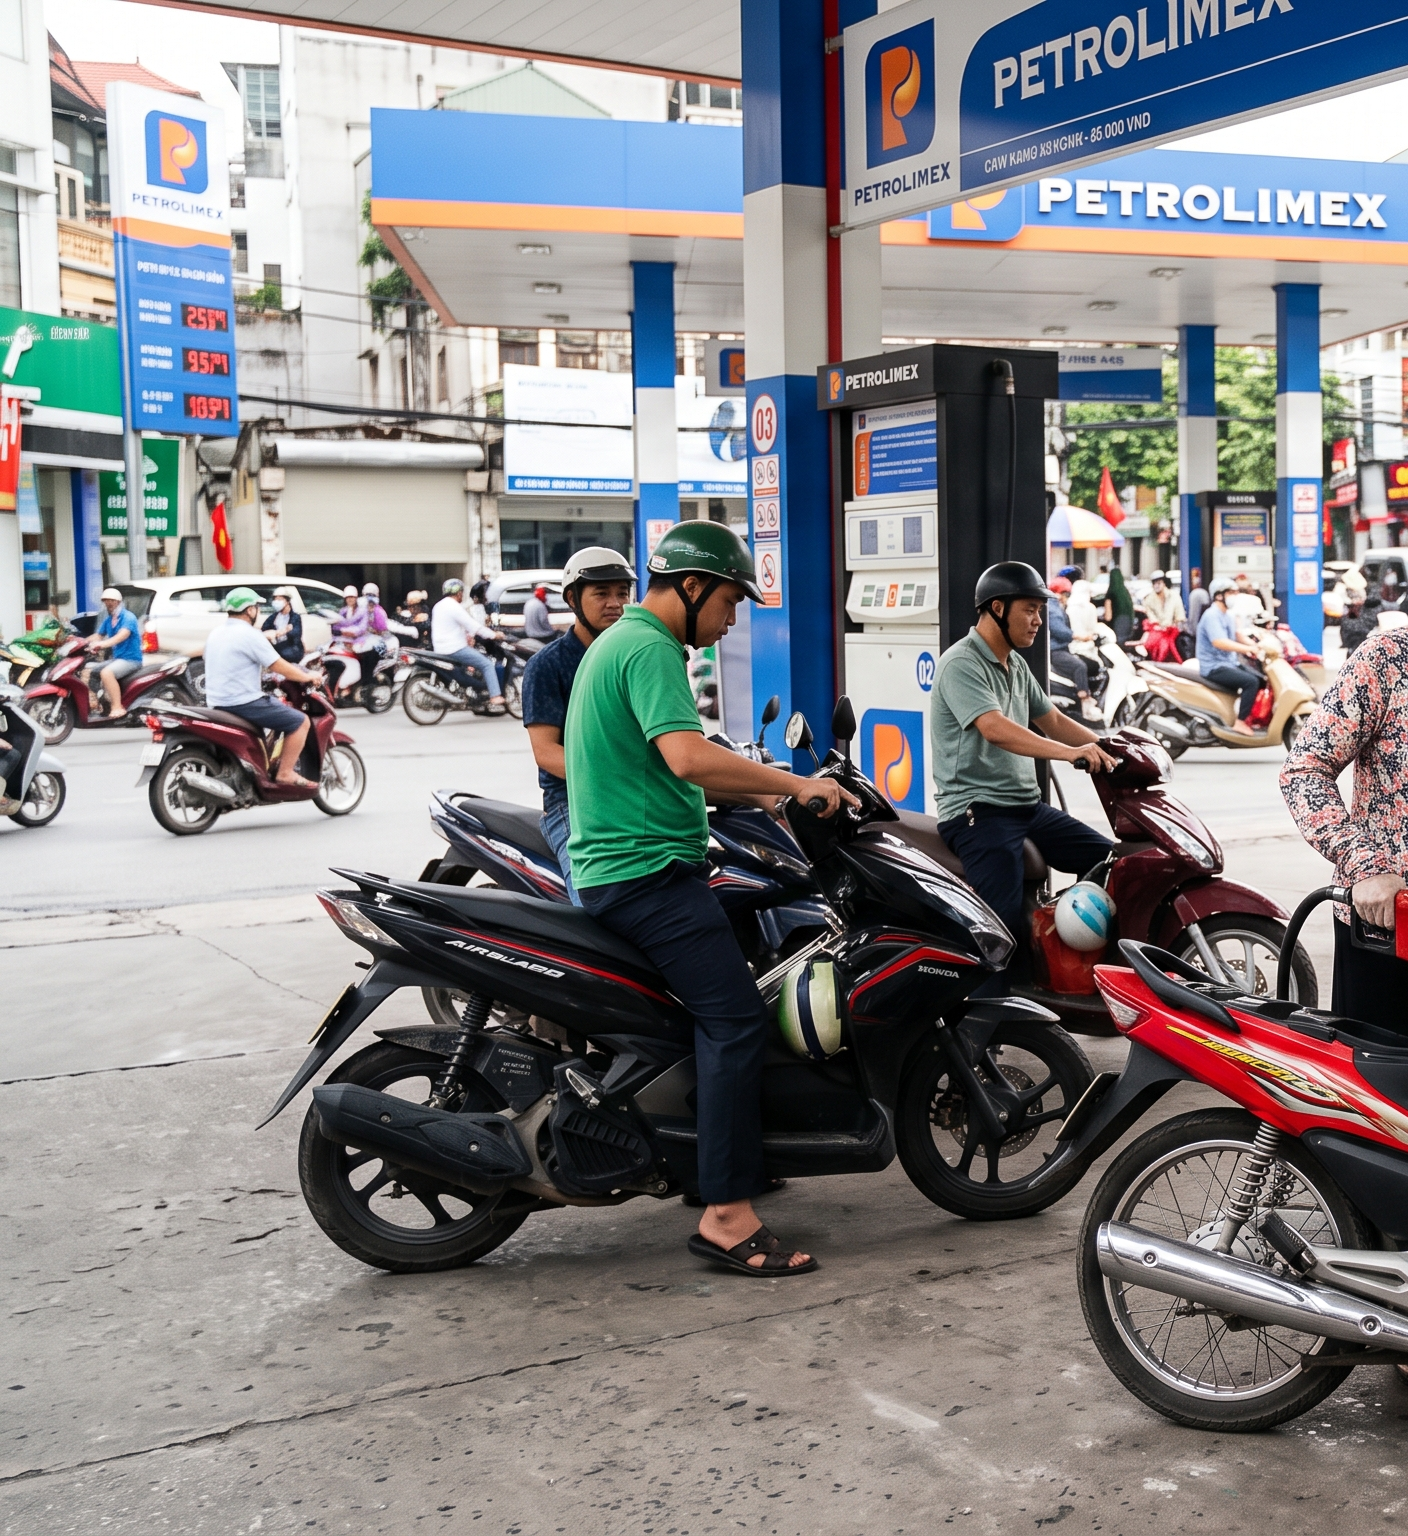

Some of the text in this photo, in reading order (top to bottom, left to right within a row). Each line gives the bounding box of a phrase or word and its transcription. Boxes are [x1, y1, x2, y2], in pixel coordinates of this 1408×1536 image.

[984, 153, 1008, 174] CAW
[1126, 111, 1151, 133] VND
[854, 161, 951, 206] PETROLIMEX
[132, 193, 224, 219] PETROLIMEX
[1038, 178, 1388, 228] PETROLIMEX
[756, 406, 773, 441] 03
[918, 660, 933, 686] 02
[917, 965, 960, 979] HONDA
